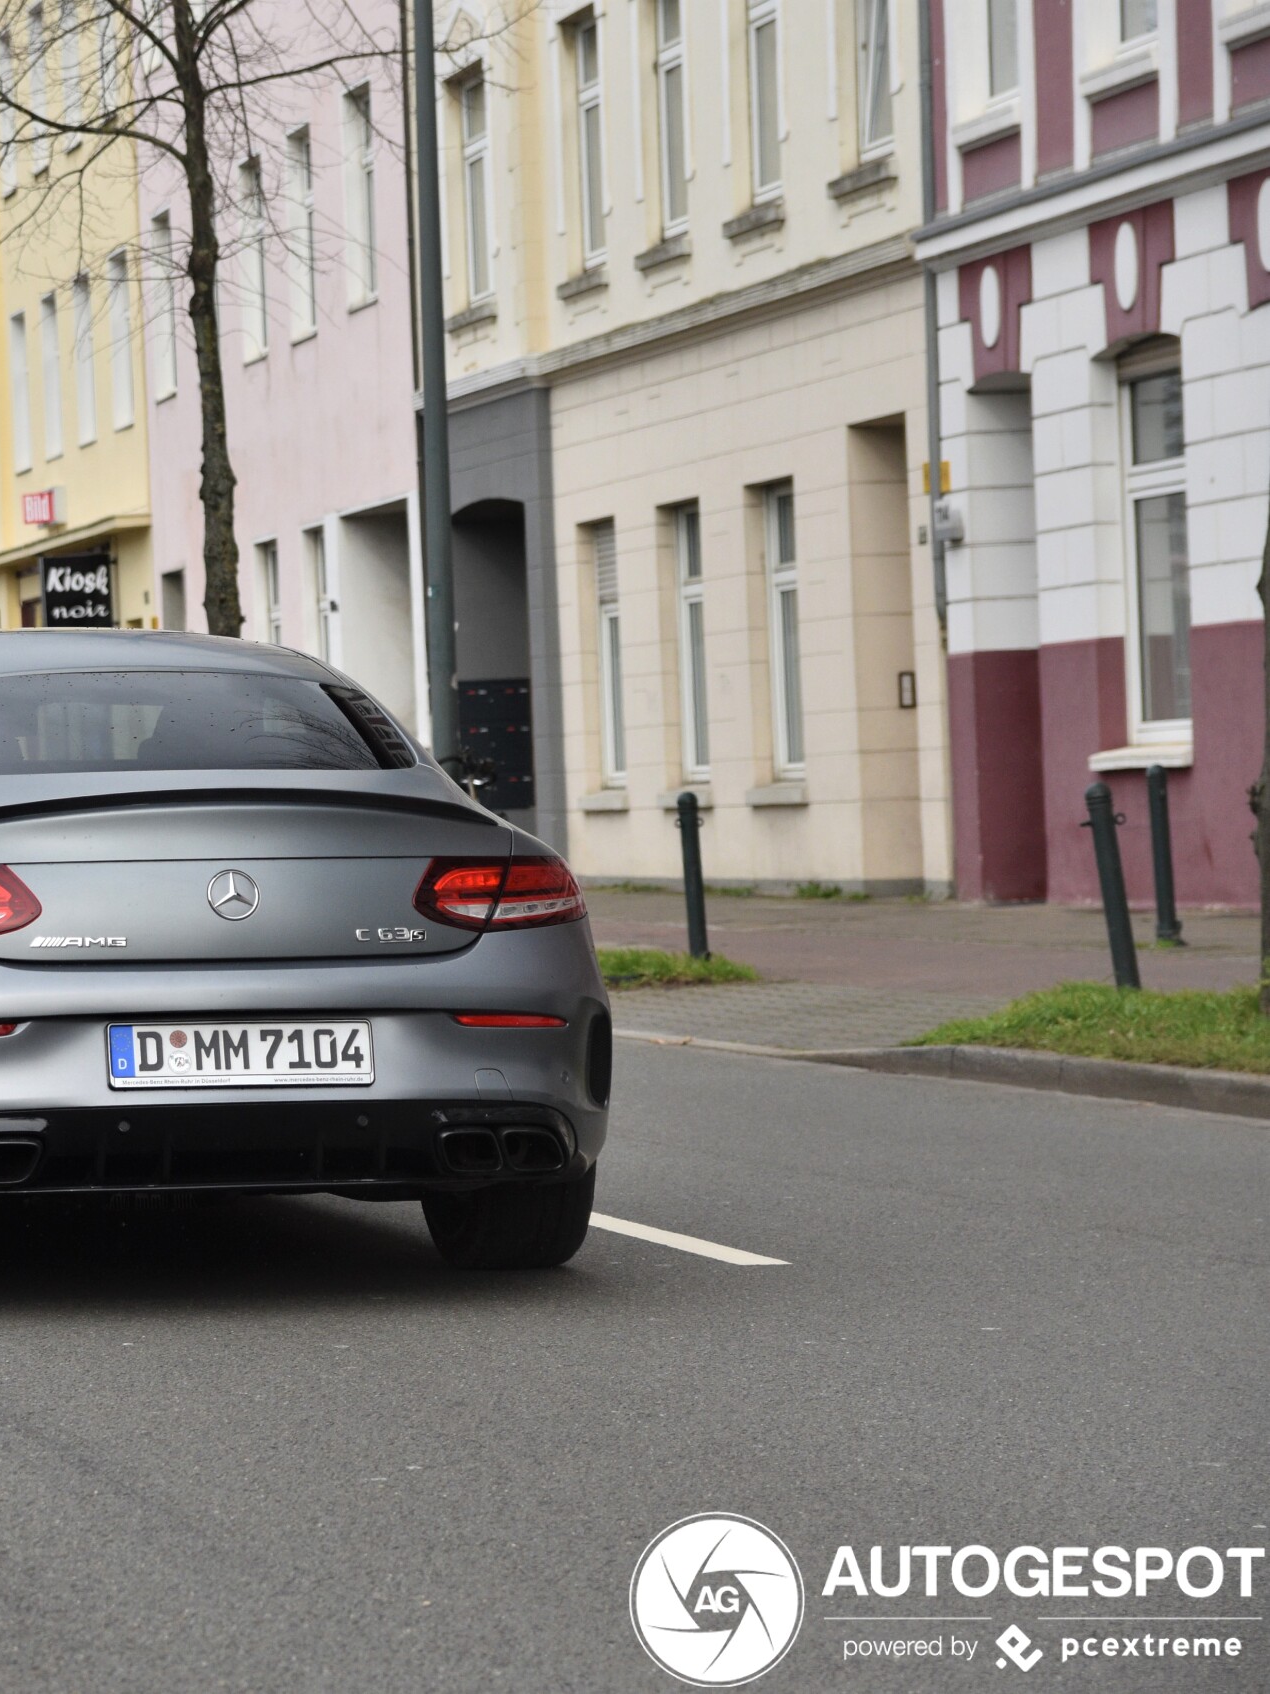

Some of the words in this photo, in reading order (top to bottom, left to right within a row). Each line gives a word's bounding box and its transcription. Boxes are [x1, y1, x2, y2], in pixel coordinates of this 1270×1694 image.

[25, 495, 50, 522] Bild
[46, 564, 109, 596] Kiosk
[52, 599, 109, 620] noir
[118, 1058, 127, 1070] D
